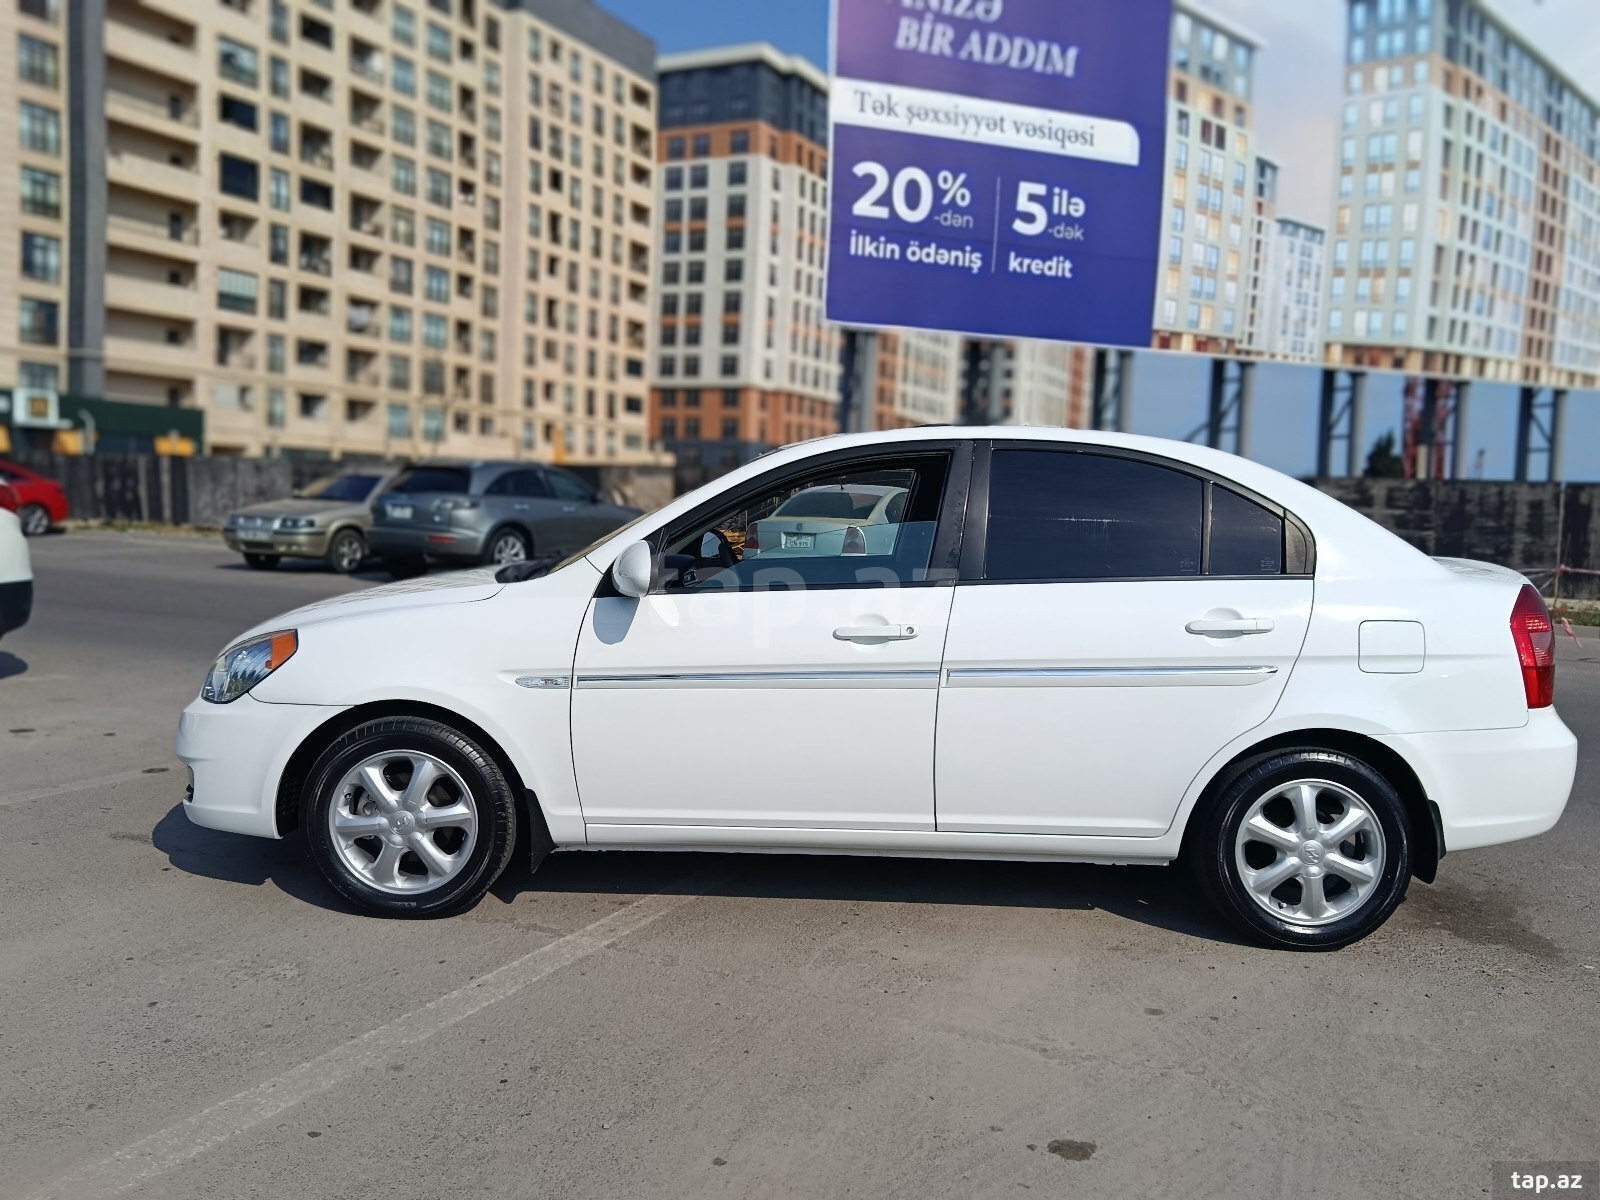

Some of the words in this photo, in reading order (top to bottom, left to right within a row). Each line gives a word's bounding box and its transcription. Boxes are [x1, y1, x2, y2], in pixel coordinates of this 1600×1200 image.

[895, 12, 955, 57] BİR
[958, 29, 1079, 78] ADDIM
[854, 90, 900, 118] Tək
[906, 103, 1005, 137] şəxsiyyət
[1012, 118, 1095, 150] vəsiqəsi
[850, 230, 900, 260] İlkin
[906, 242, 982, 273] ödəniş
[1008, 252, 1073, 278] kredit
